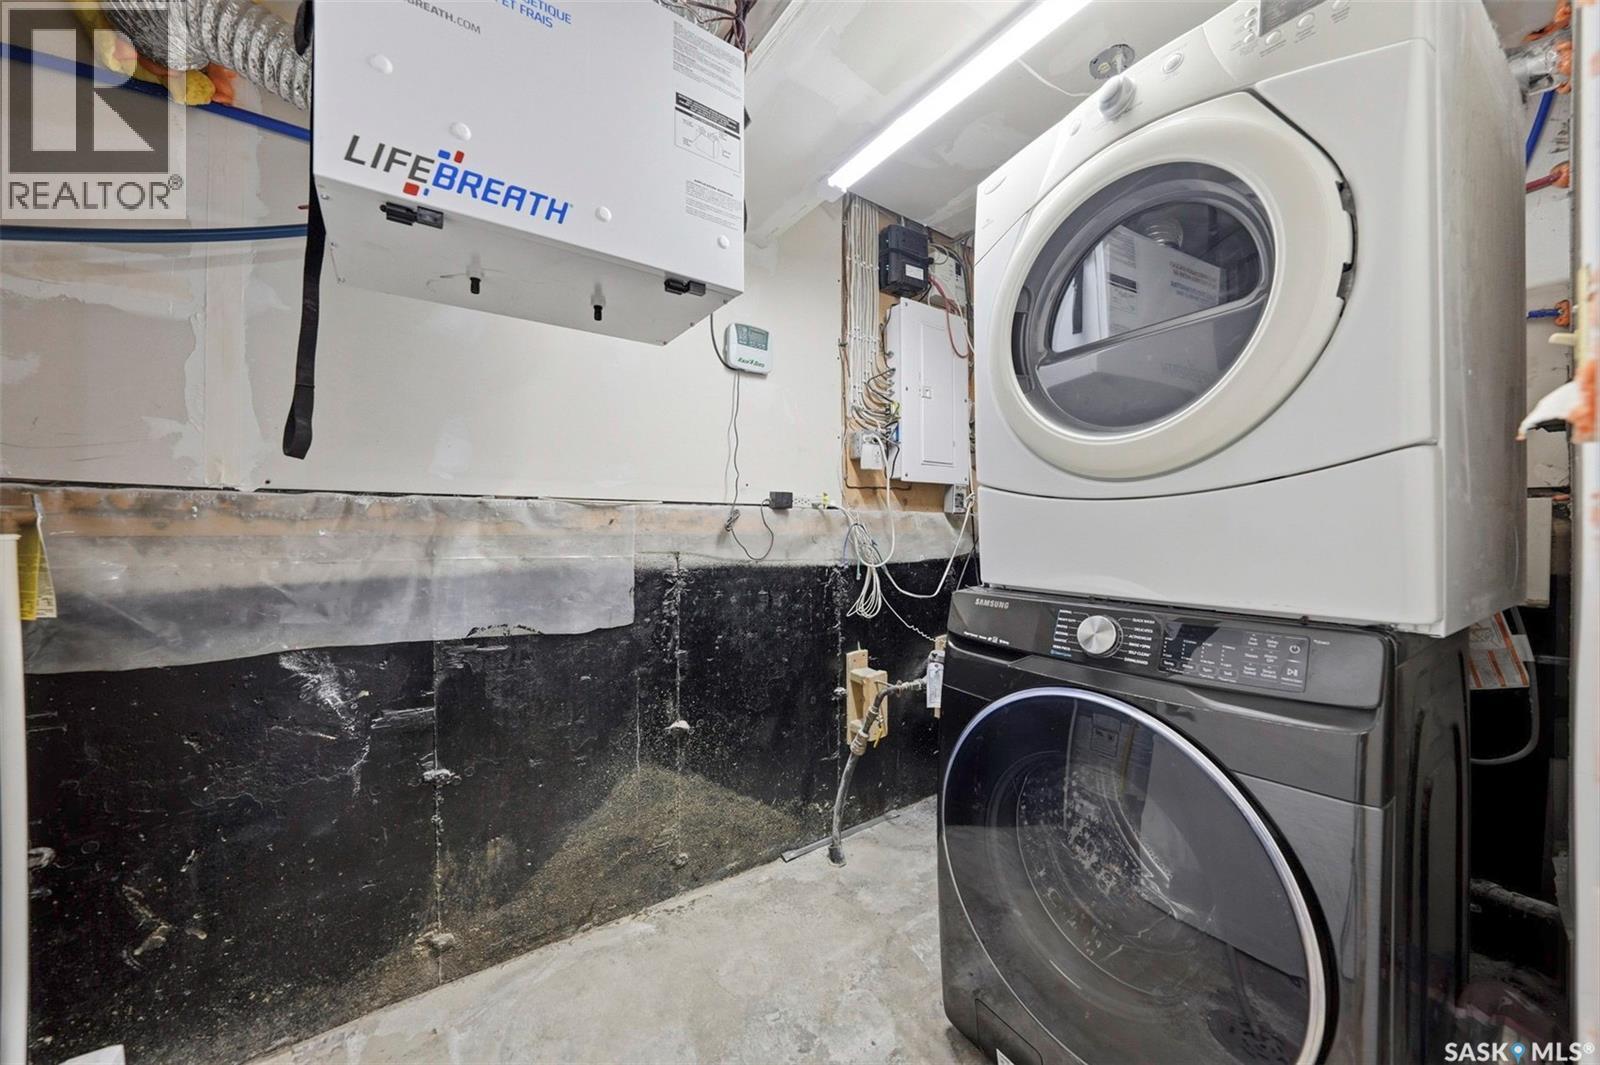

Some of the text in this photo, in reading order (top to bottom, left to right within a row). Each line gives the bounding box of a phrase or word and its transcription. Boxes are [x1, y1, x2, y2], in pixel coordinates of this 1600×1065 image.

[519, 4, 553, 28] FRAIS
[344, 134, 569, 225] LIFEBREATH
[974, 598, 1010, 610] SAMSUNG
